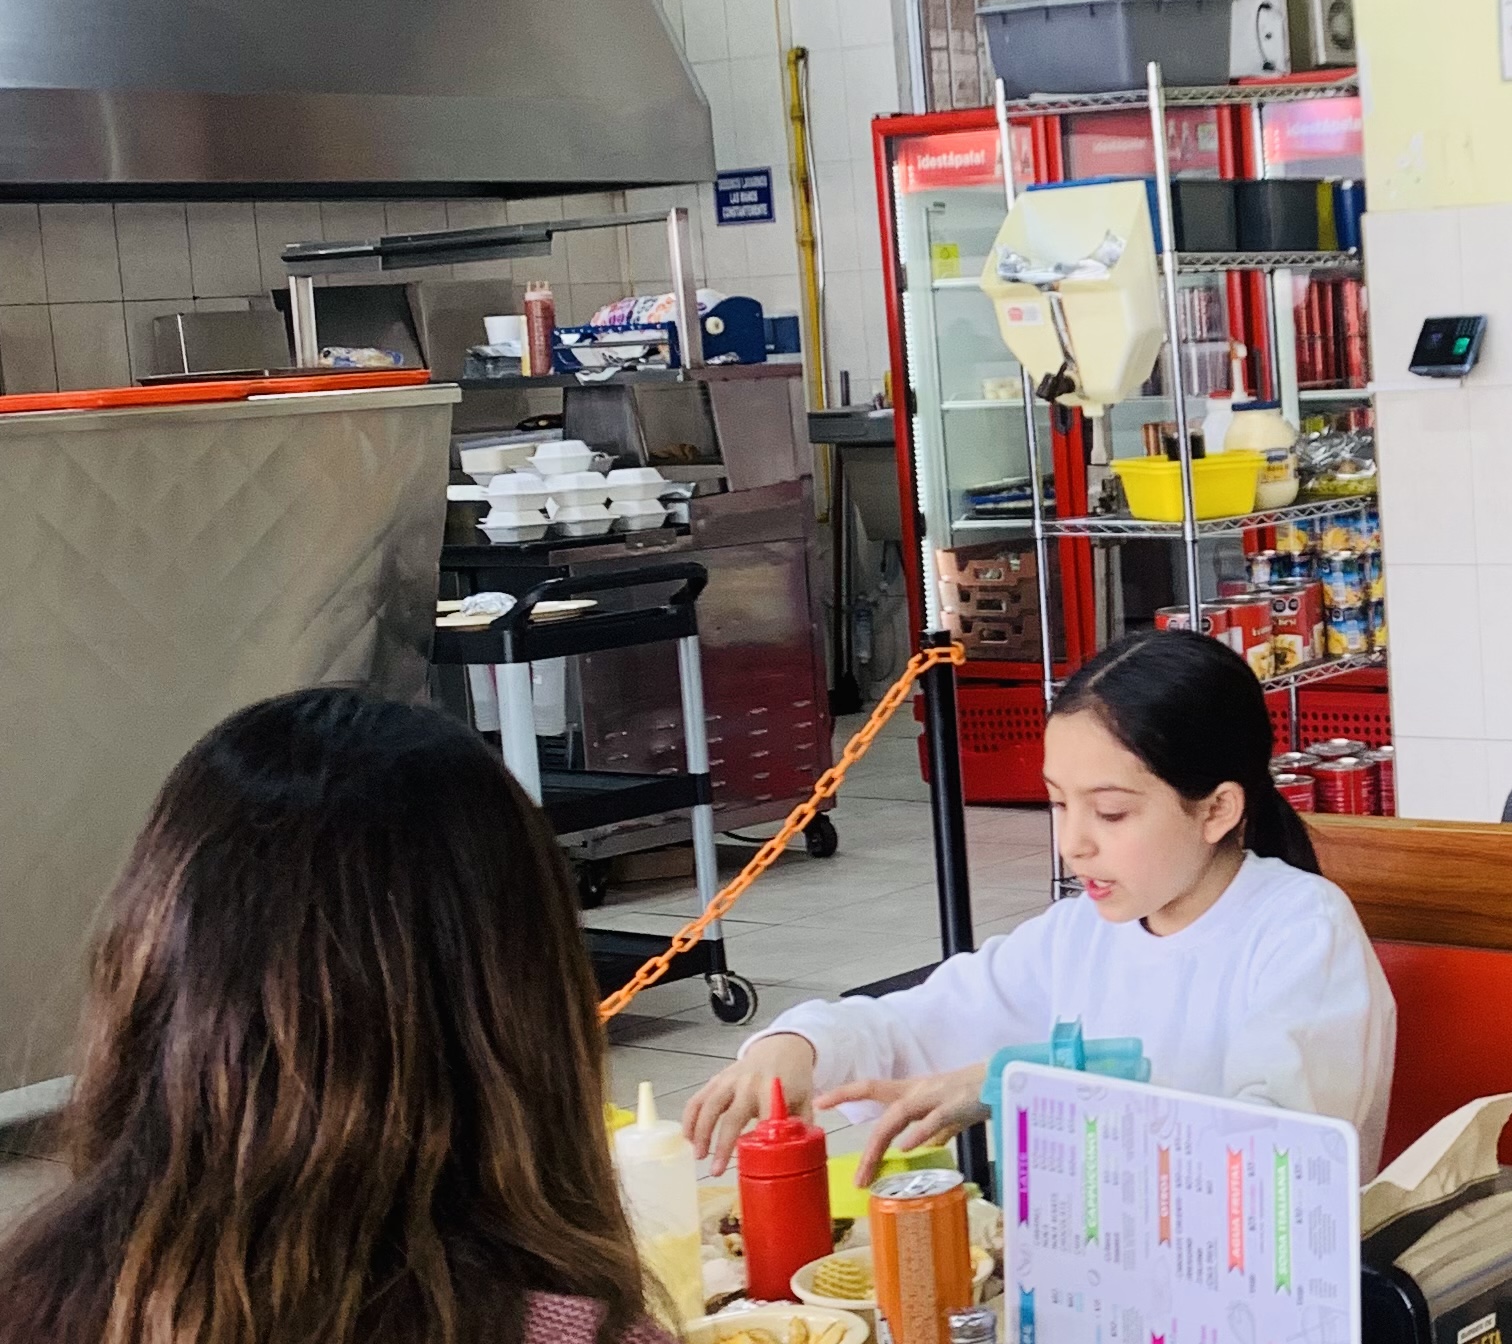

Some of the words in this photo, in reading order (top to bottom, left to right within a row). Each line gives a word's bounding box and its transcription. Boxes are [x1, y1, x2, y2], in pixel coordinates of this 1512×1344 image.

[1230, 1164, 1240, 1215] FRUTAL
[1276, 1164, 1287, 1231] ITALIANA
[1231, 1217, 1241, 1257] AGUA
[1278, 1234, 1288, 1276] SODA
